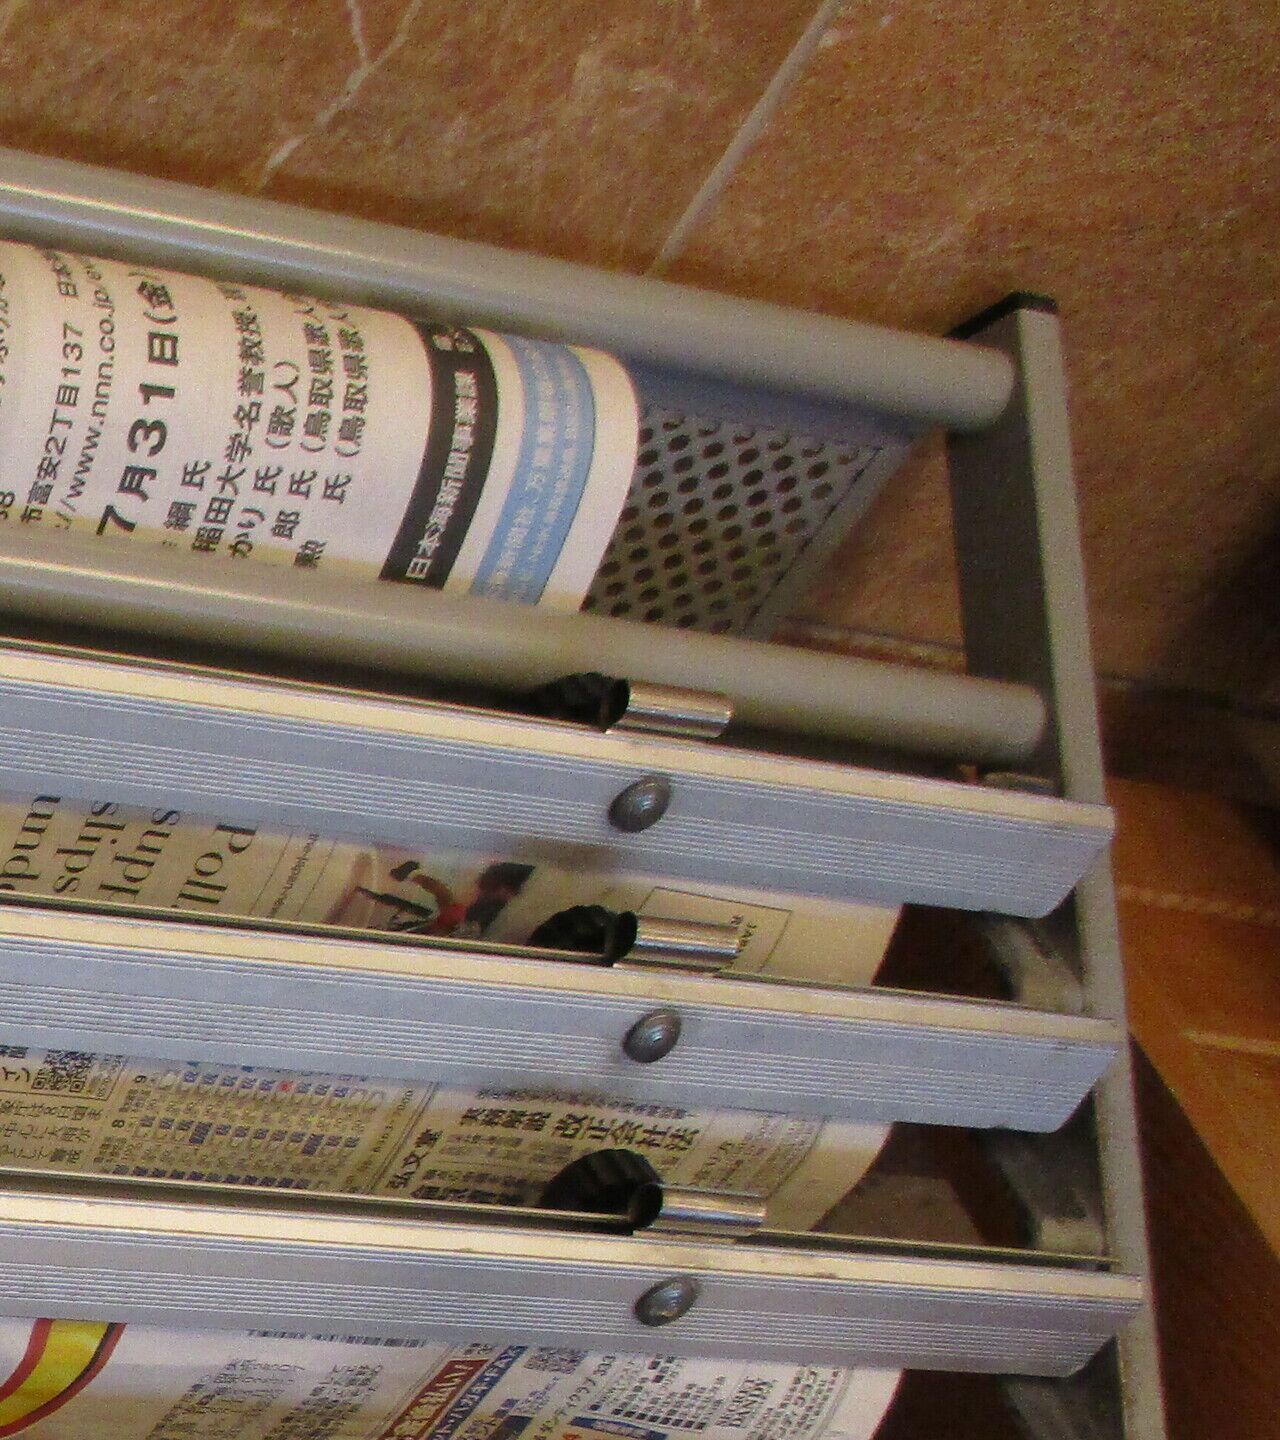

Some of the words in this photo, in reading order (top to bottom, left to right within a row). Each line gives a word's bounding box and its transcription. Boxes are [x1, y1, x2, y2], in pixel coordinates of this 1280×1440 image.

[95, 272, 178, 537] 7月31日(金)
[52, 801, 126, 894] slips
